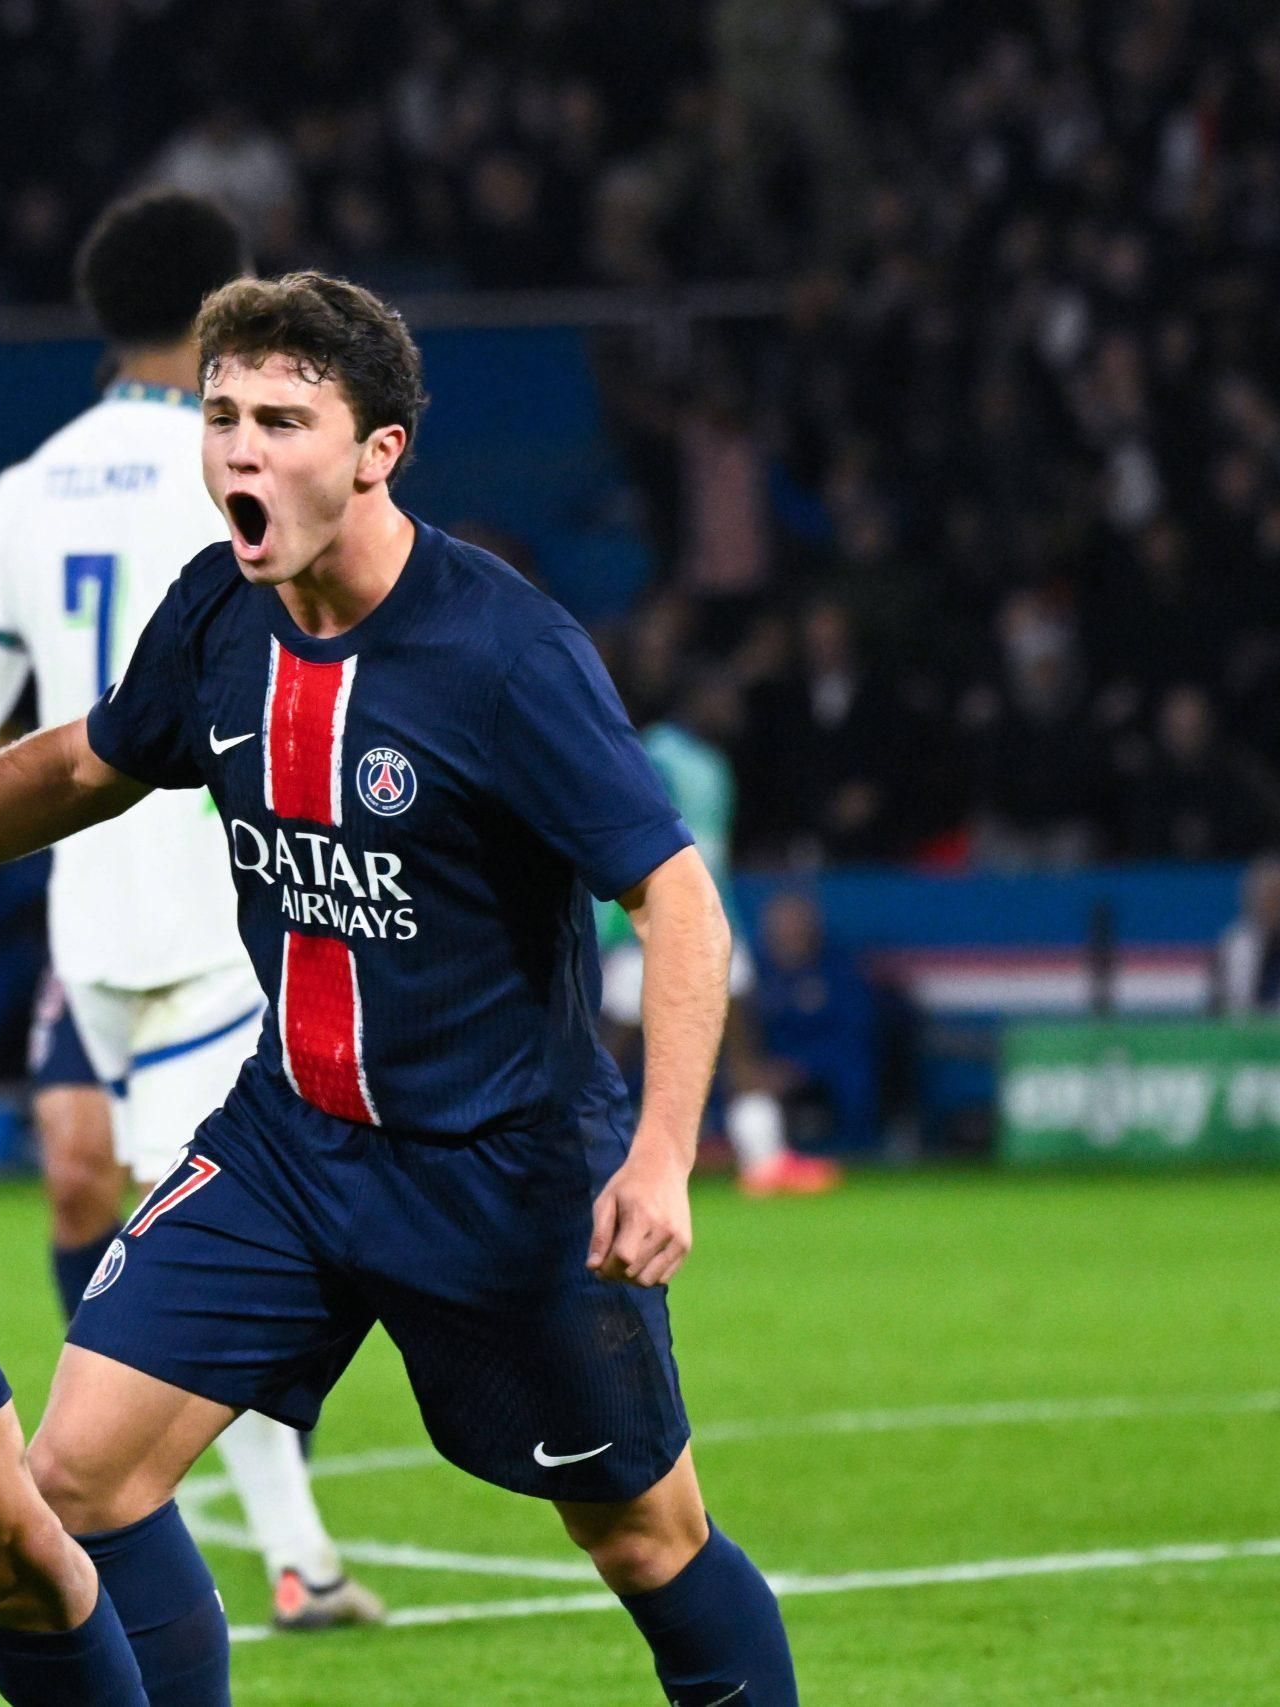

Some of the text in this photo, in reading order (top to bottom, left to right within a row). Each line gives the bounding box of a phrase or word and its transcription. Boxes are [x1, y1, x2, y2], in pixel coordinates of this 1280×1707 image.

[64, 553, 128, 702] 7
[366, 751, 407, 771] PARIS
[231, 818, 413, 901] QATAR
[281, 884, 418, 940] AIRWAYS
